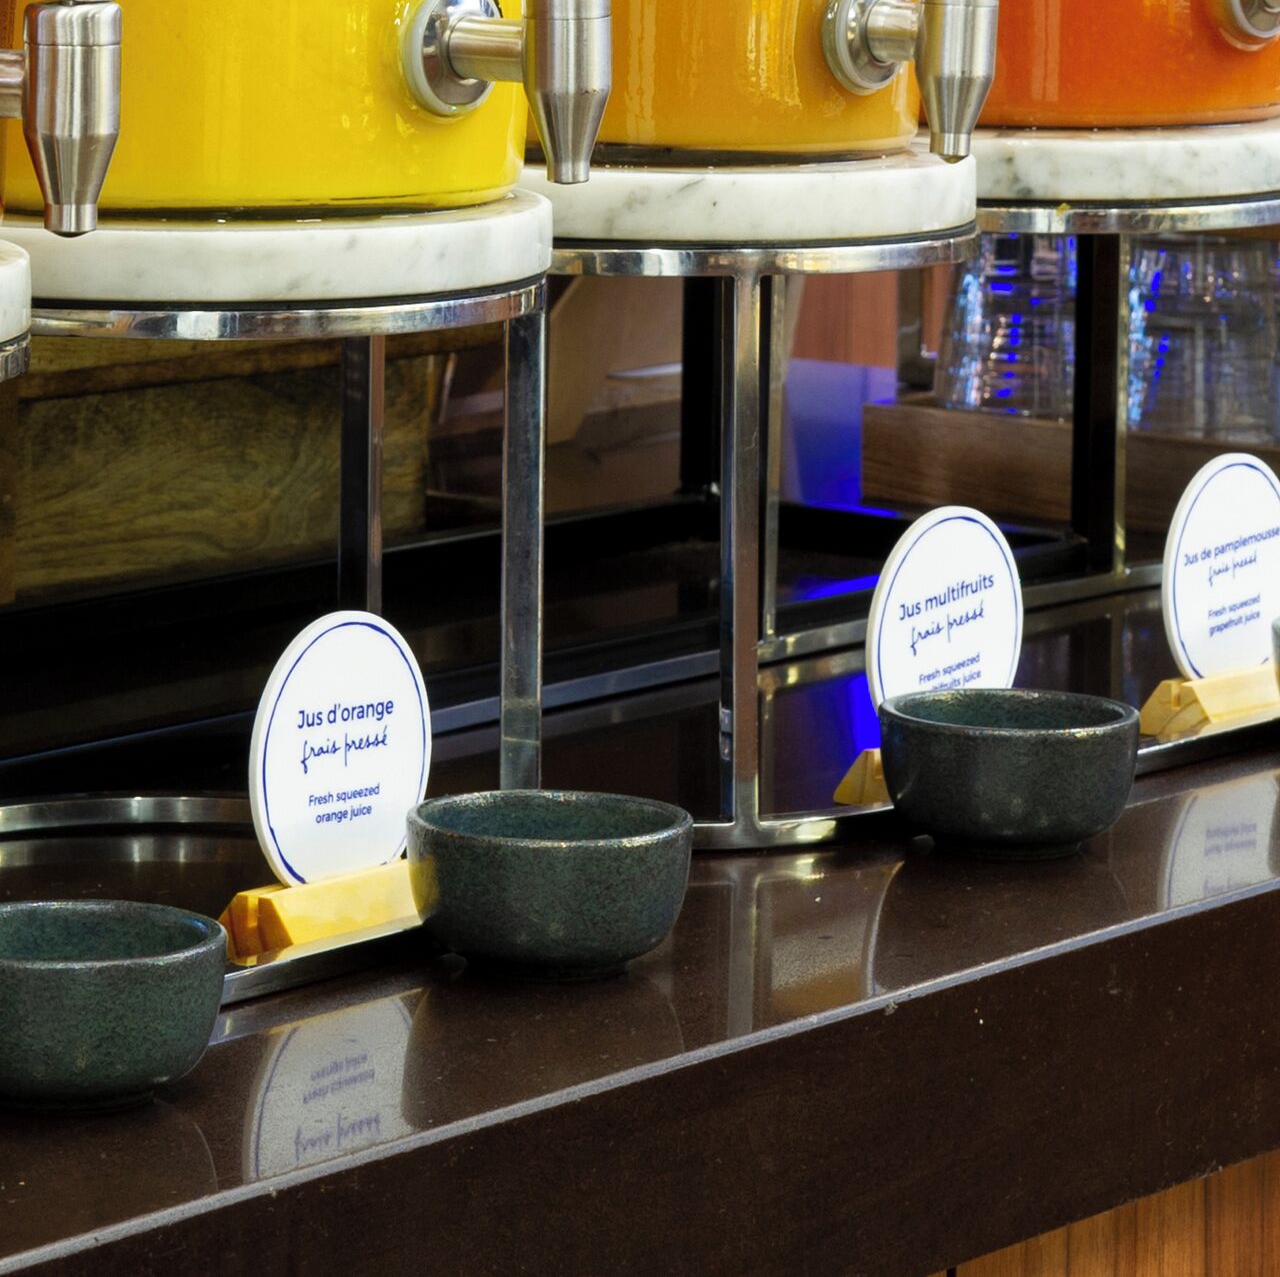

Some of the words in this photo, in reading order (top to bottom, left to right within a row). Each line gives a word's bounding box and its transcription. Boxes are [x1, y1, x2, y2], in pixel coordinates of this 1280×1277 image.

[1183, 553, 1199, 567] Jus
[1200, 547, 1212, 561] de
[1214, 526, 1280, 558] pamplemousse
[898, 602, 922, 622] Jus
[925, 573, 995, 612] multifruits
[1207, 605, 1227, 620] Fresh
[1228, 594, 1261, 614] squeezed
[910, 622, 944, 657] frais
[947, 599, 985, 643] pressé
[1208, 616, 1243, 638] grapefruit
[1243, 610, 1261, 626] juice
[918, 668, 941, 685] Fresh
[942, 651, 981, 676] squeezed
[963, 669, 982, 687] juice
[297, 709, 324, 729] Jus
[327, 698, 395, 725] d'orange
[300, 740, 340, 774] frais
[344, 725, 388, 767] pressé
[308, 791, 335, 808] Fresh
[336, 782, 381, 804] squeezed
[315, 808, 349, 825] orange
[349, 803, 373, 822] juice
